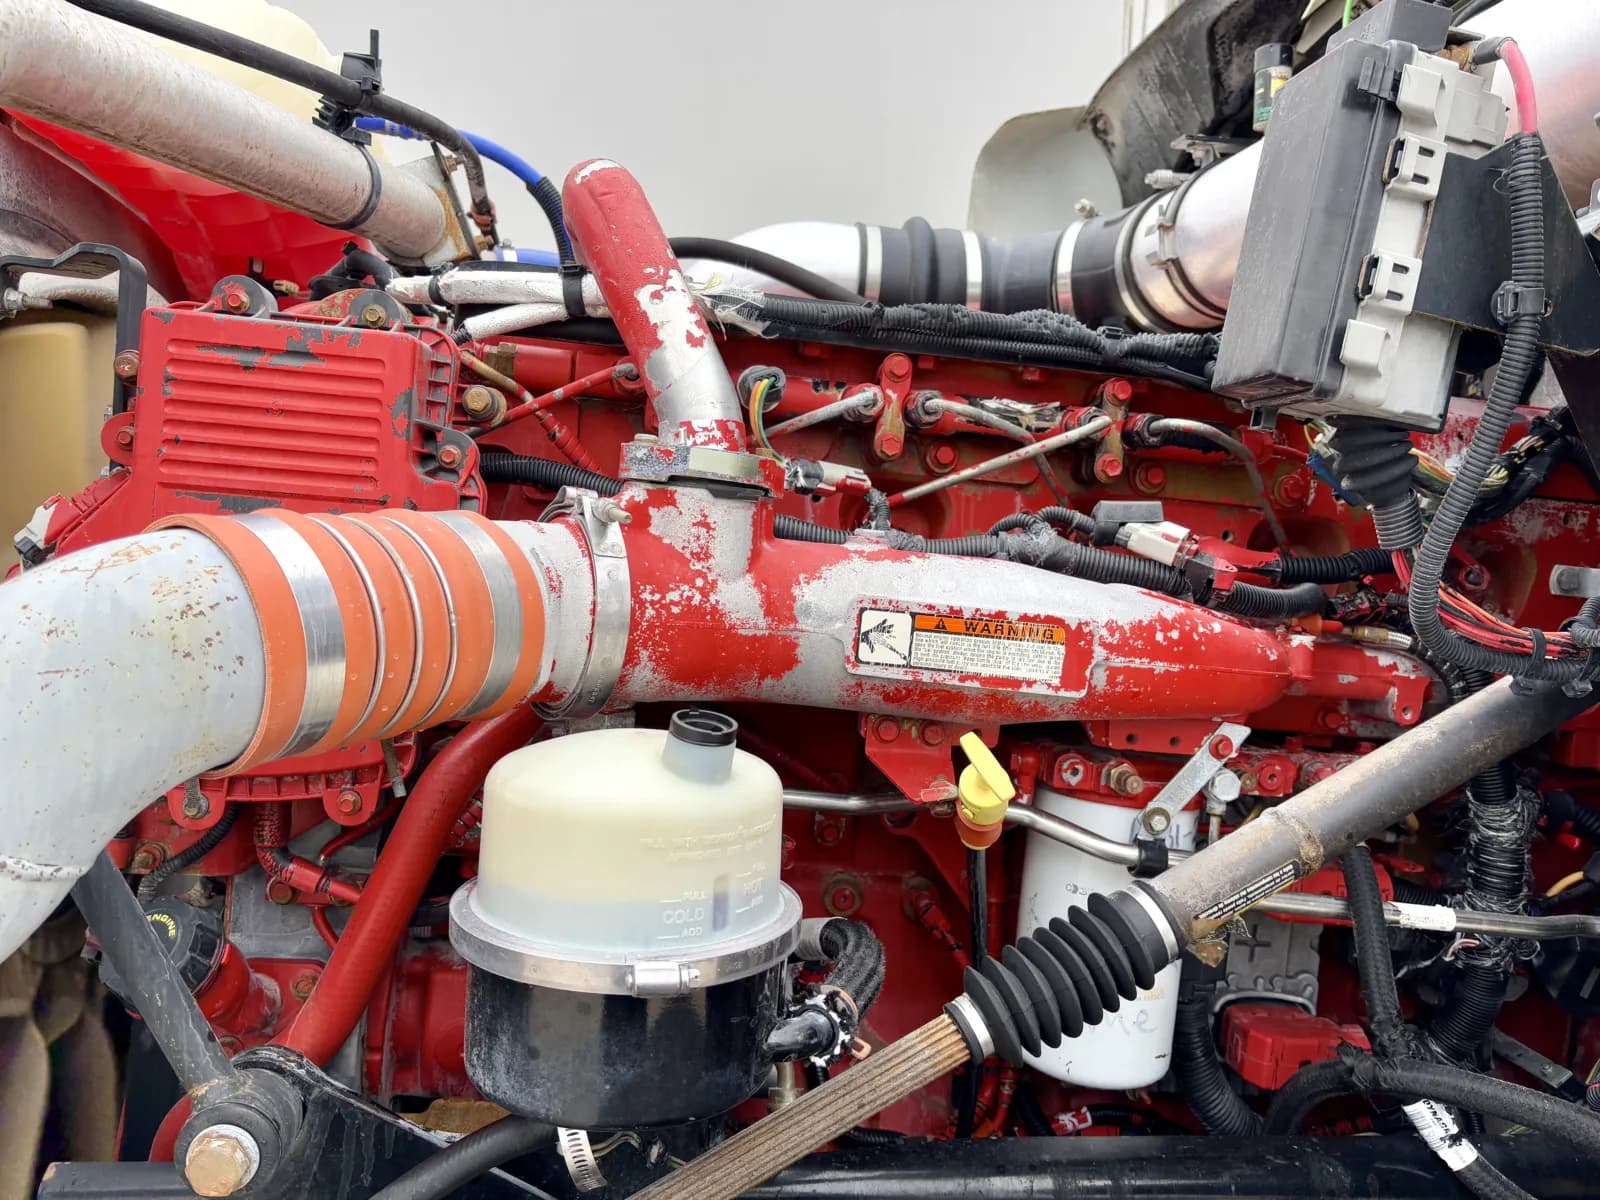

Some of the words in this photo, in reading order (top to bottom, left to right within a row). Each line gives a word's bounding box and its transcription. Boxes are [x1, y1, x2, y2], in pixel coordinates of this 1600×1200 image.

[964, 620, 1054, 640] WARNING
[146, 913, 177, 937] ENGINE
[663, 908, 705, 924] COLD
